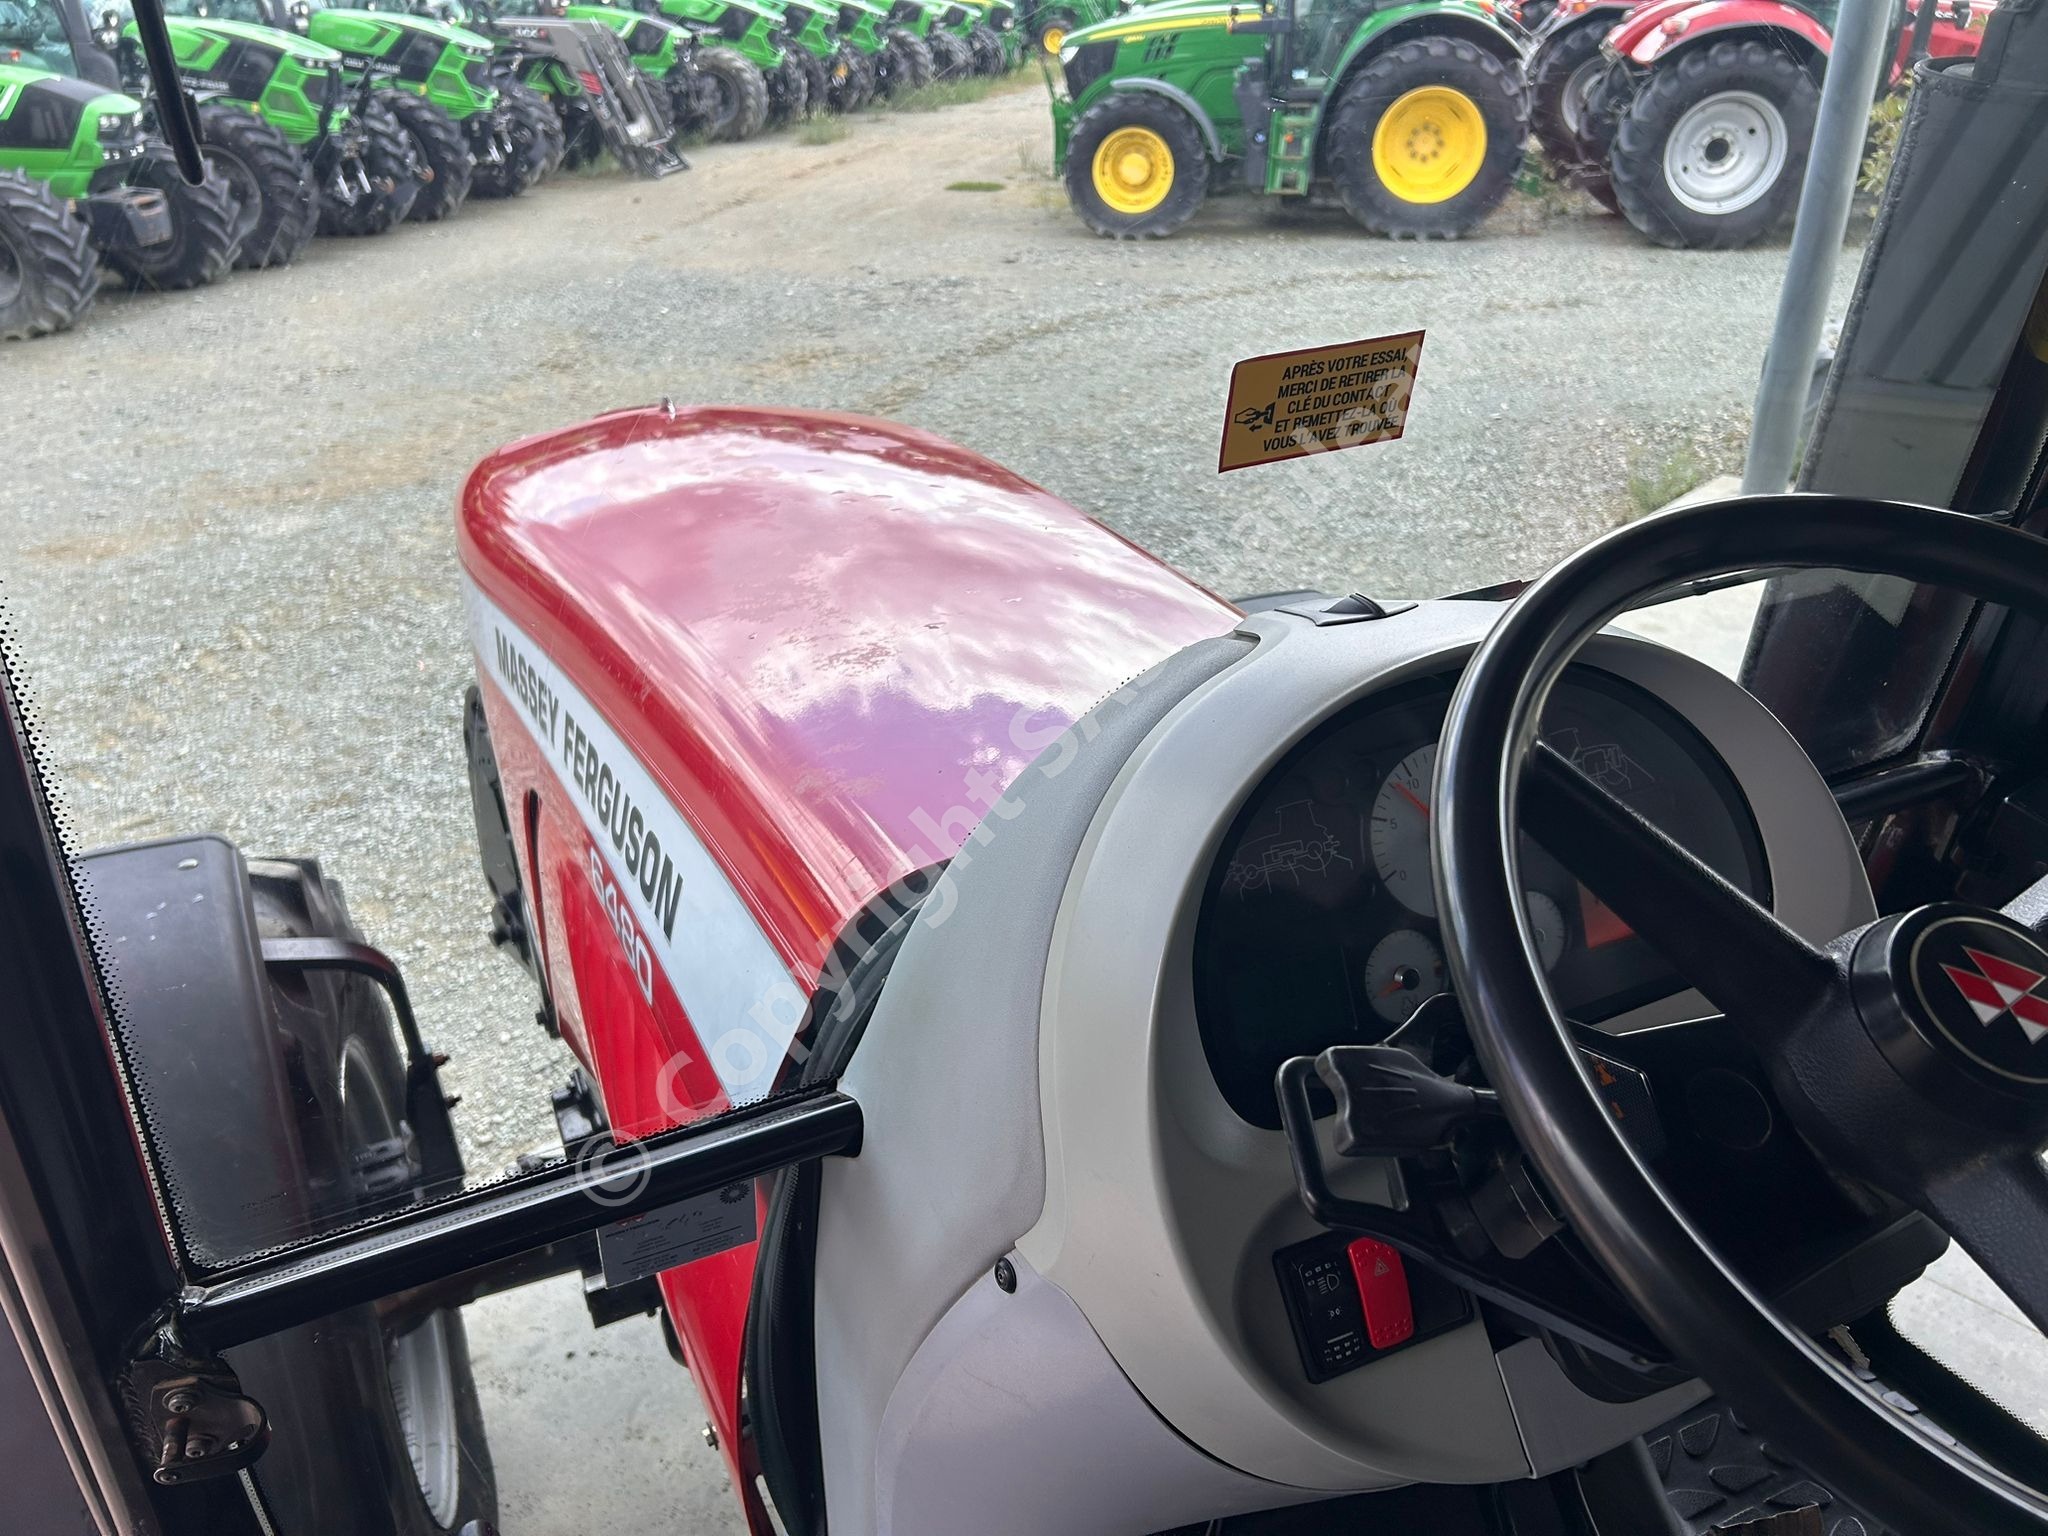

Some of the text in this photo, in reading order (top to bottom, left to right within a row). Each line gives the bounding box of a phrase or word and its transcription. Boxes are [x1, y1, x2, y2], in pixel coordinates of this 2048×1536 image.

[1278, 365, 1406, 399] MERCI DE RETIRER LA
[1282, 348, 1408, 381] APRÈS VOTRE ESSAI,
[1275, 397, 1397, 434] ET REMETTEZ-LA OÙ
[1287, 384, 1392, 414] CLÉ DU CONTACT
[1263, 416, 1399, 452] VOUS L'AVEZ TROUVÉE
[495, 627, 684, 942] MASSEY FERGUSON
[1390, 818, 1398, 830] 5
[590, 847, 653, 1007] 6480
